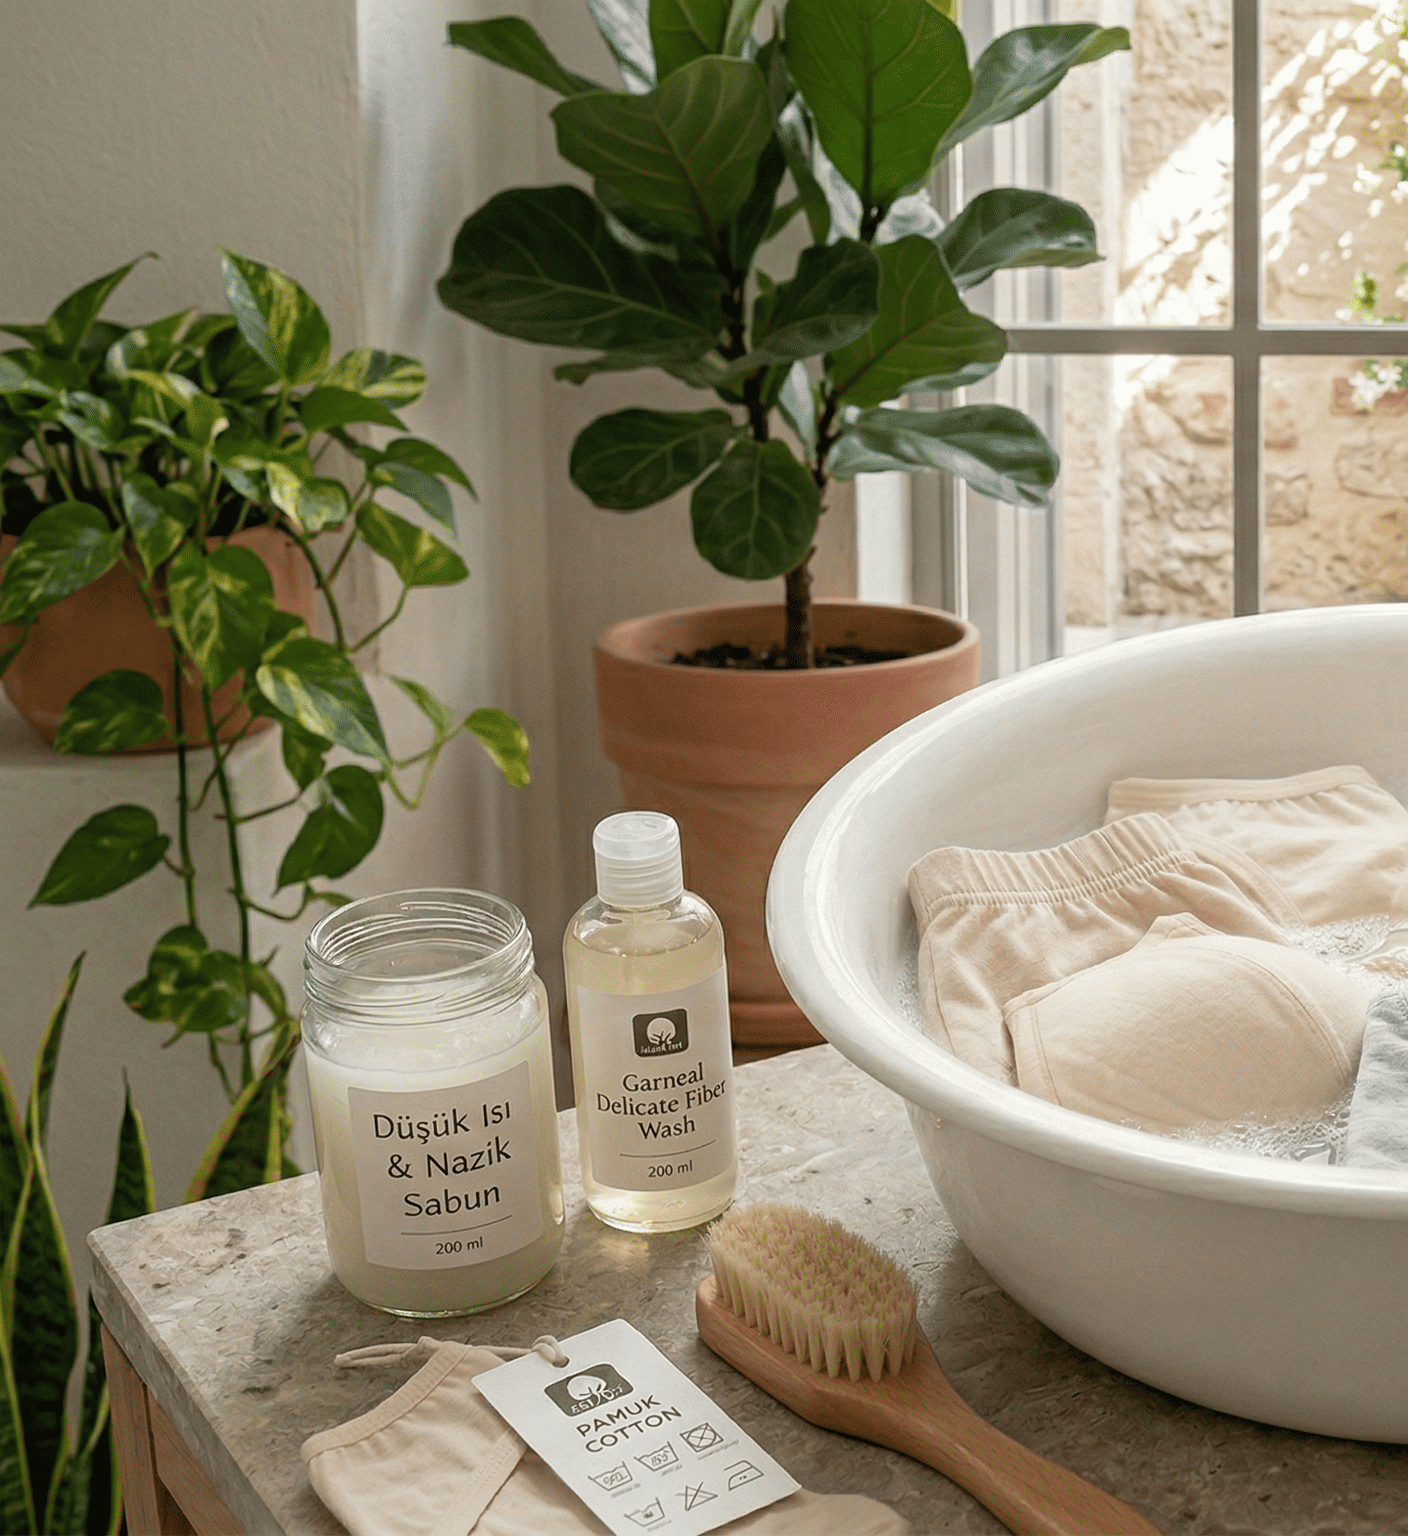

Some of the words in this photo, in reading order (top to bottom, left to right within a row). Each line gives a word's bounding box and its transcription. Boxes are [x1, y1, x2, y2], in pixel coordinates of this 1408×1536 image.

[622, 1061, 704, 1092] Garneal
[596, 1092, 679, 1116] Delicate
[685, 1079, 726, 1110] Fiber
[373, 1108, 471, 1145] Düşük
[482, 1100, 511, 1128] Isı
[637, 1115, 696, 1140] Wash
[387, 1154, 413, 1179] &
[426, 1136, 512, 1178] Nazik
[648, 1164, 674, 1178] 200
[677, 1160, 693, 1174] ml
[404, 1186, 500, 1217] Sabun
[435, 1240, 462, 1255] 200
[467, 1236, 483, 1250] ml
[576, 1395, 662, 1438] PAMUK
[585, 1407, 682, 1453] COTTON
